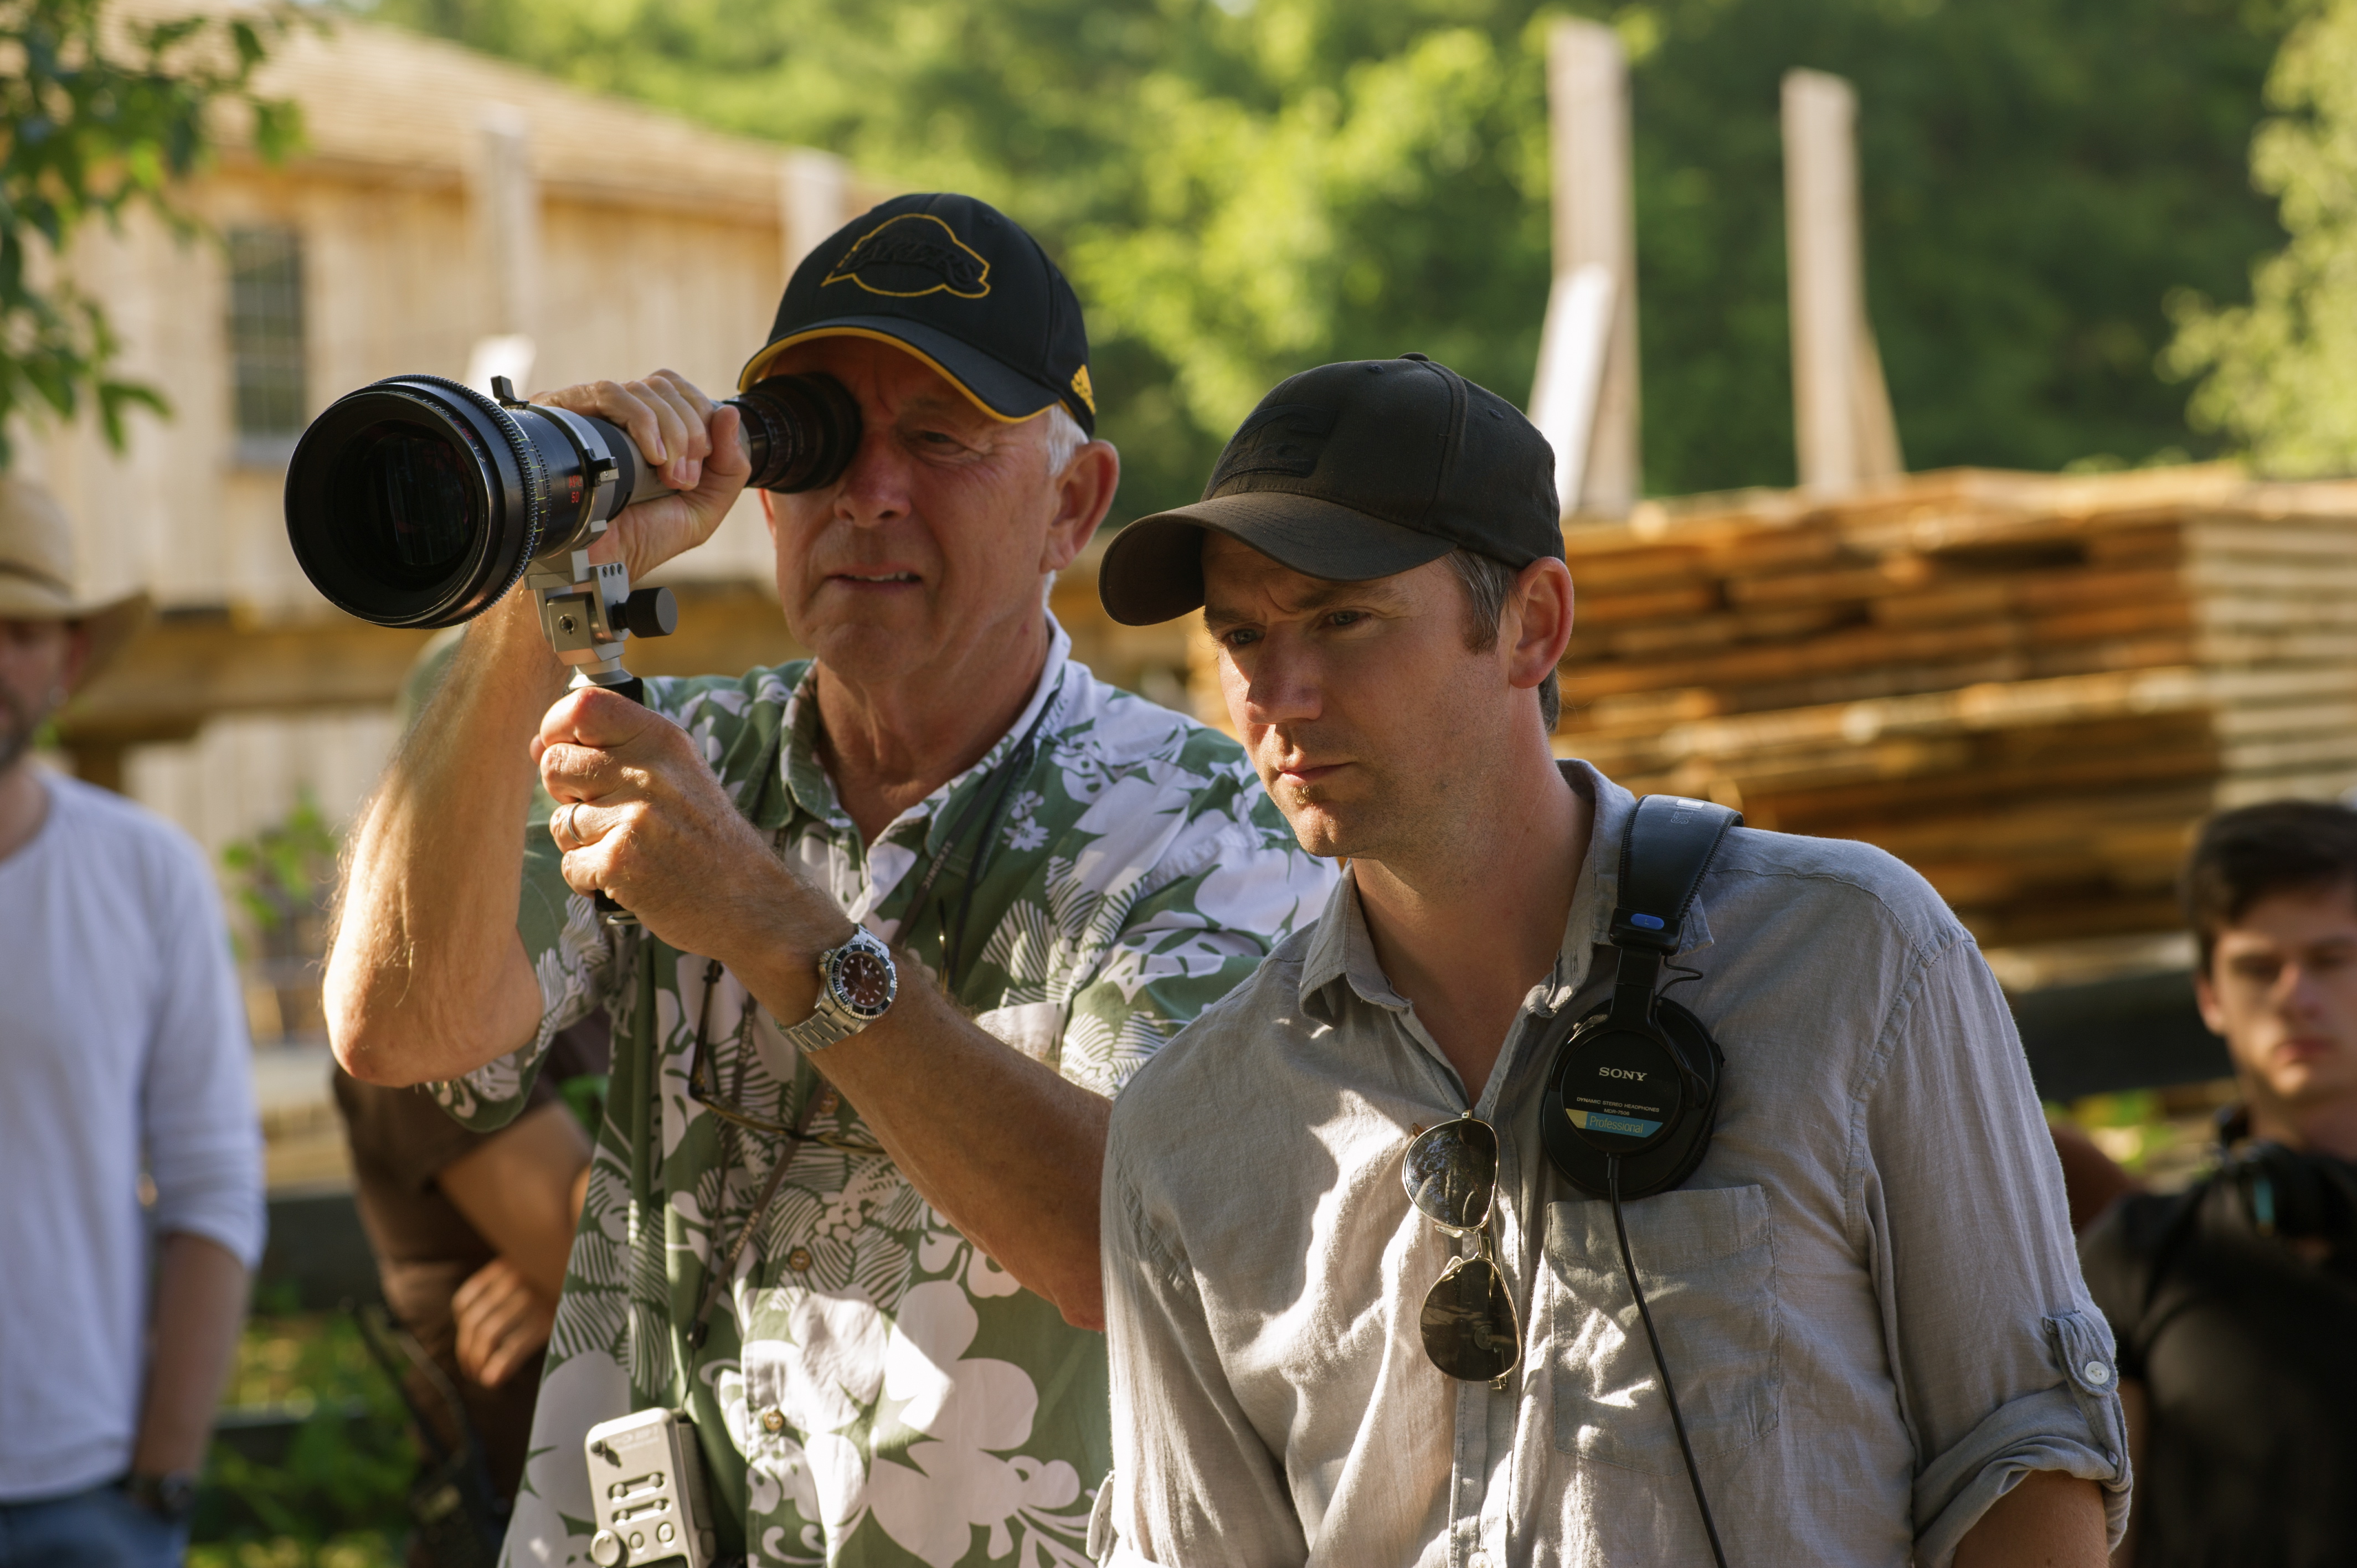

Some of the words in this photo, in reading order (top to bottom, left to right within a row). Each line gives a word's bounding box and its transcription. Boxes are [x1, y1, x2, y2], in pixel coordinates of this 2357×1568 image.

[569, 476, 583, 488] APL
[571, 491, 580, 503] 50
[1599, 1067, 1648, 1081] SONY
[1624, 1103, 1660, 1112] HEADPHONES
[1589, 1116, 1644, 1133] Professional
